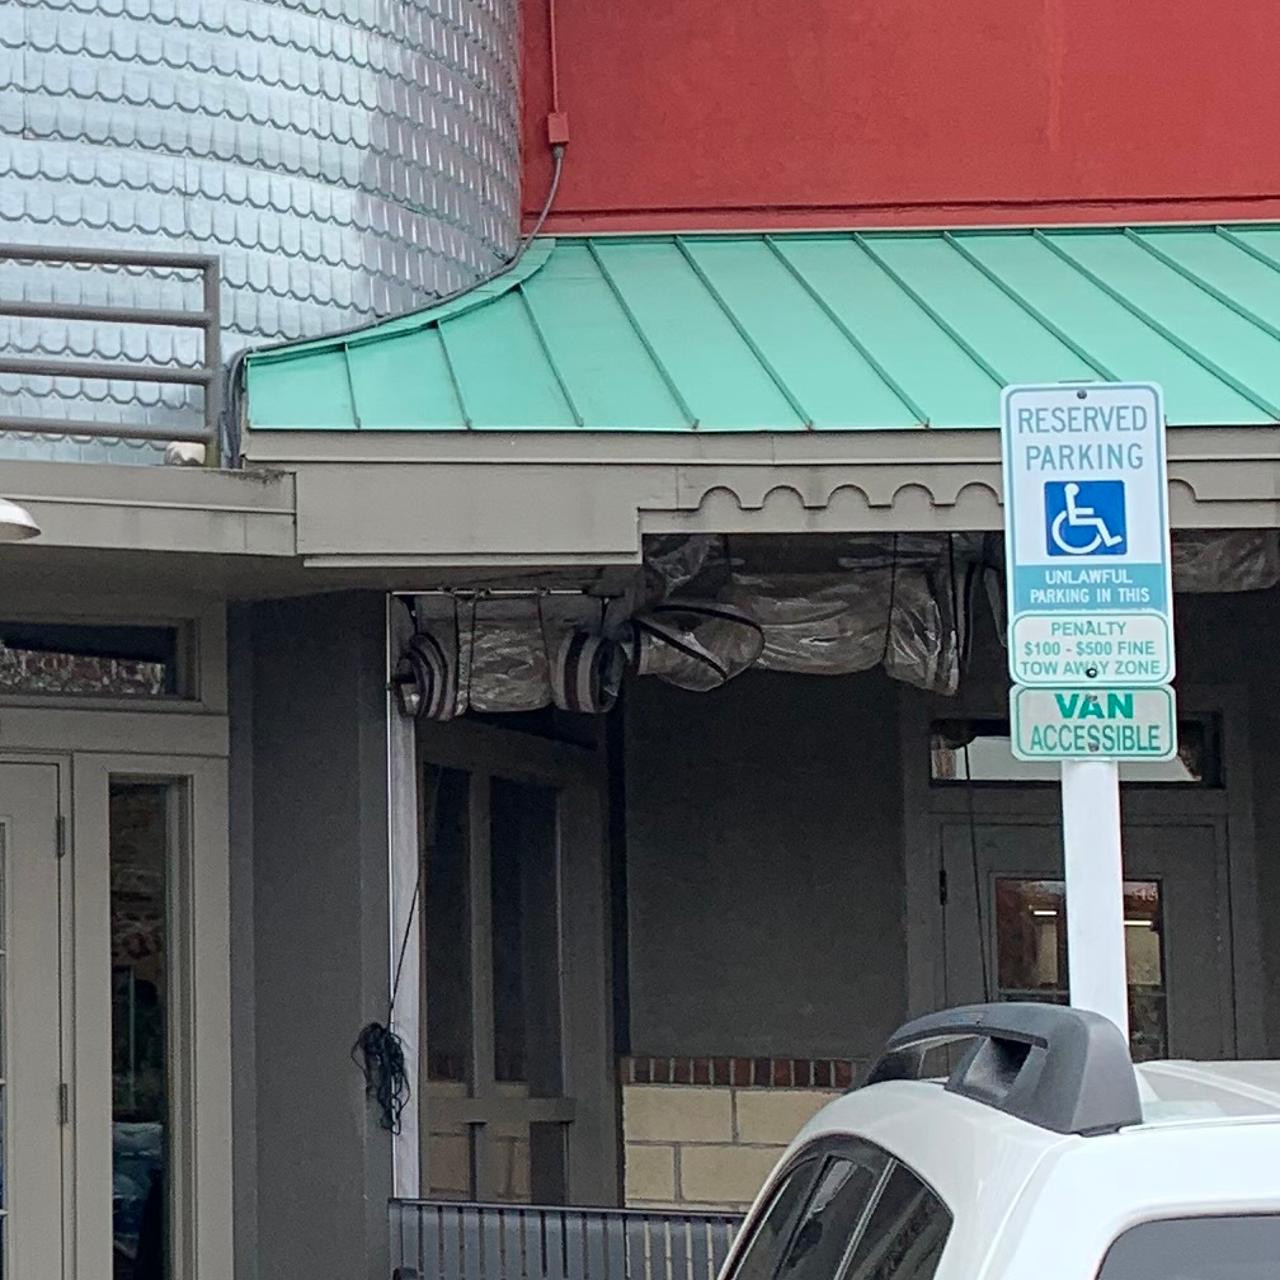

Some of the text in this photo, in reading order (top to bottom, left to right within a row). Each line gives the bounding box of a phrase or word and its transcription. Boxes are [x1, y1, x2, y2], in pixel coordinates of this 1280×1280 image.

[1017, 406, 1148, 434] RESERVED
[1026, 443, 1144, 471] PARKING
[1045, 569, 1133, 584] UNLAWFUL
[1030, 588, 1150, 604] PARKING IN THIS
[1051, 621, 1126, 636] PENALTY
[1024, 641, 1061, 656] $100
[1076, 641, 1113, 656] $500
[1117, 640, 1155, 655] FINE
[1020, 660, 1161, 676] TOW AWAY ZONE
[1054, 693, 1134, 720] VAN
[1030, 725, 1162, 752] ACCESSIBLE
